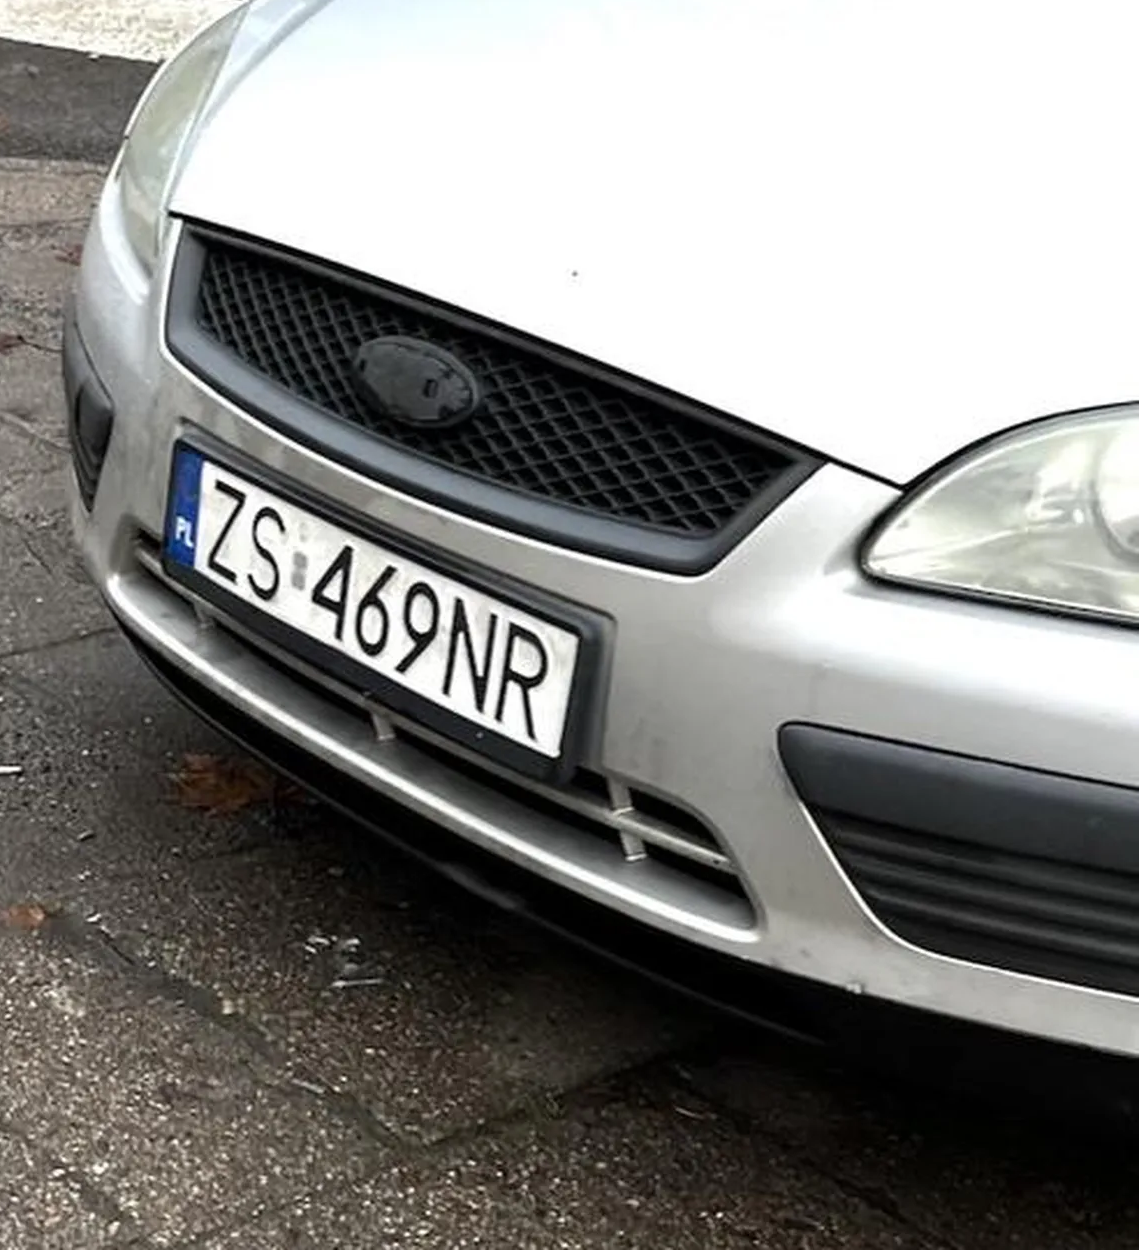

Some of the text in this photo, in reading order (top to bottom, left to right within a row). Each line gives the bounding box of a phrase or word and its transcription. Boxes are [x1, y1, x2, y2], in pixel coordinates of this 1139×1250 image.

[175, 515, 194, 548] PL
[206, 478, 549, 742] ZS 469NR
